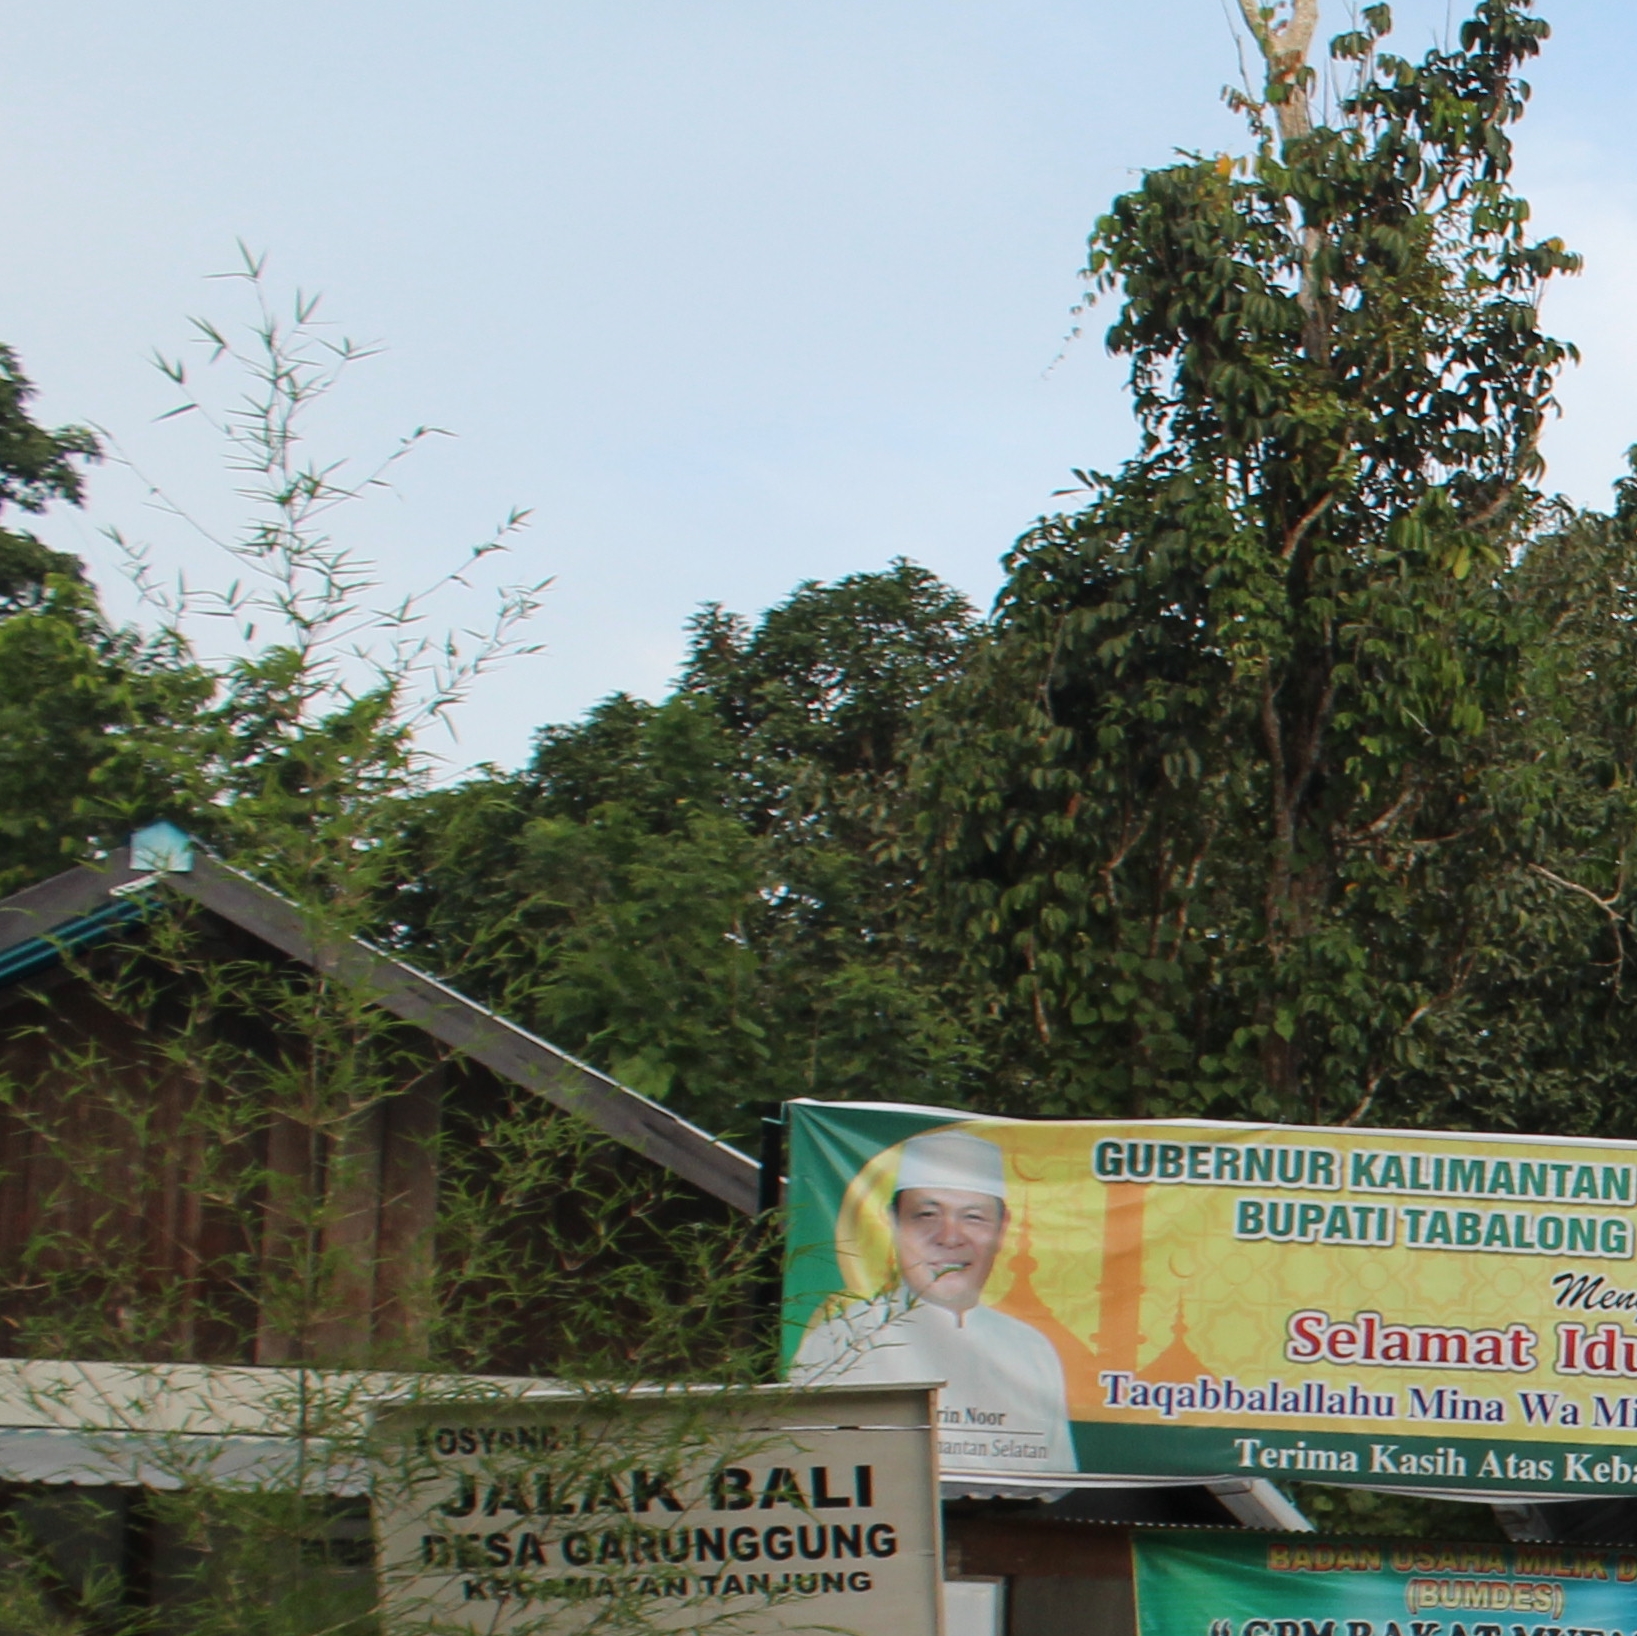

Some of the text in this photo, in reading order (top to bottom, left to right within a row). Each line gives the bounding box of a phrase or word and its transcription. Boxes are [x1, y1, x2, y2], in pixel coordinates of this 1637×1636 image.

[1096, 1141, 1335, 1186] GUBERNUR
[1350, 1152, 1631, 1201] KALIMANTAN
[1237, 1200, 1389, 1242] BUPATI
[1403, 1208, 1628, 1255] TABALONG
[1291, 1315, 1533, 1368] Selamat
[965, 1407, 1006, 1426] Noor
[1101, 1374, 1394, 1419] Taqabbalallahu
[1408, 1387, 1504, 1423] Mina
[1518, 1391, 1580, 1426] Wa
[1235, 1439, 1358, 1474] Terima
[1370, 1444, 1467, 1478] Kasih
[1477, 1449, 1553, 1482] Atas
[440, 1465, 872, 1517] JALAK BALI
[421, 1523, 897, 1568] DESA GARUNGGUNG
[1267, 1544, 1381, 1573] BADAN
[1391, 1545, 1506, 1574] USAHA
[1515, 1547, 1608, 1580] MILIK
[700, 1571, 872, 1597] TANJUNG
[1406, 1577, 1565, 1620] (BUMDES)
